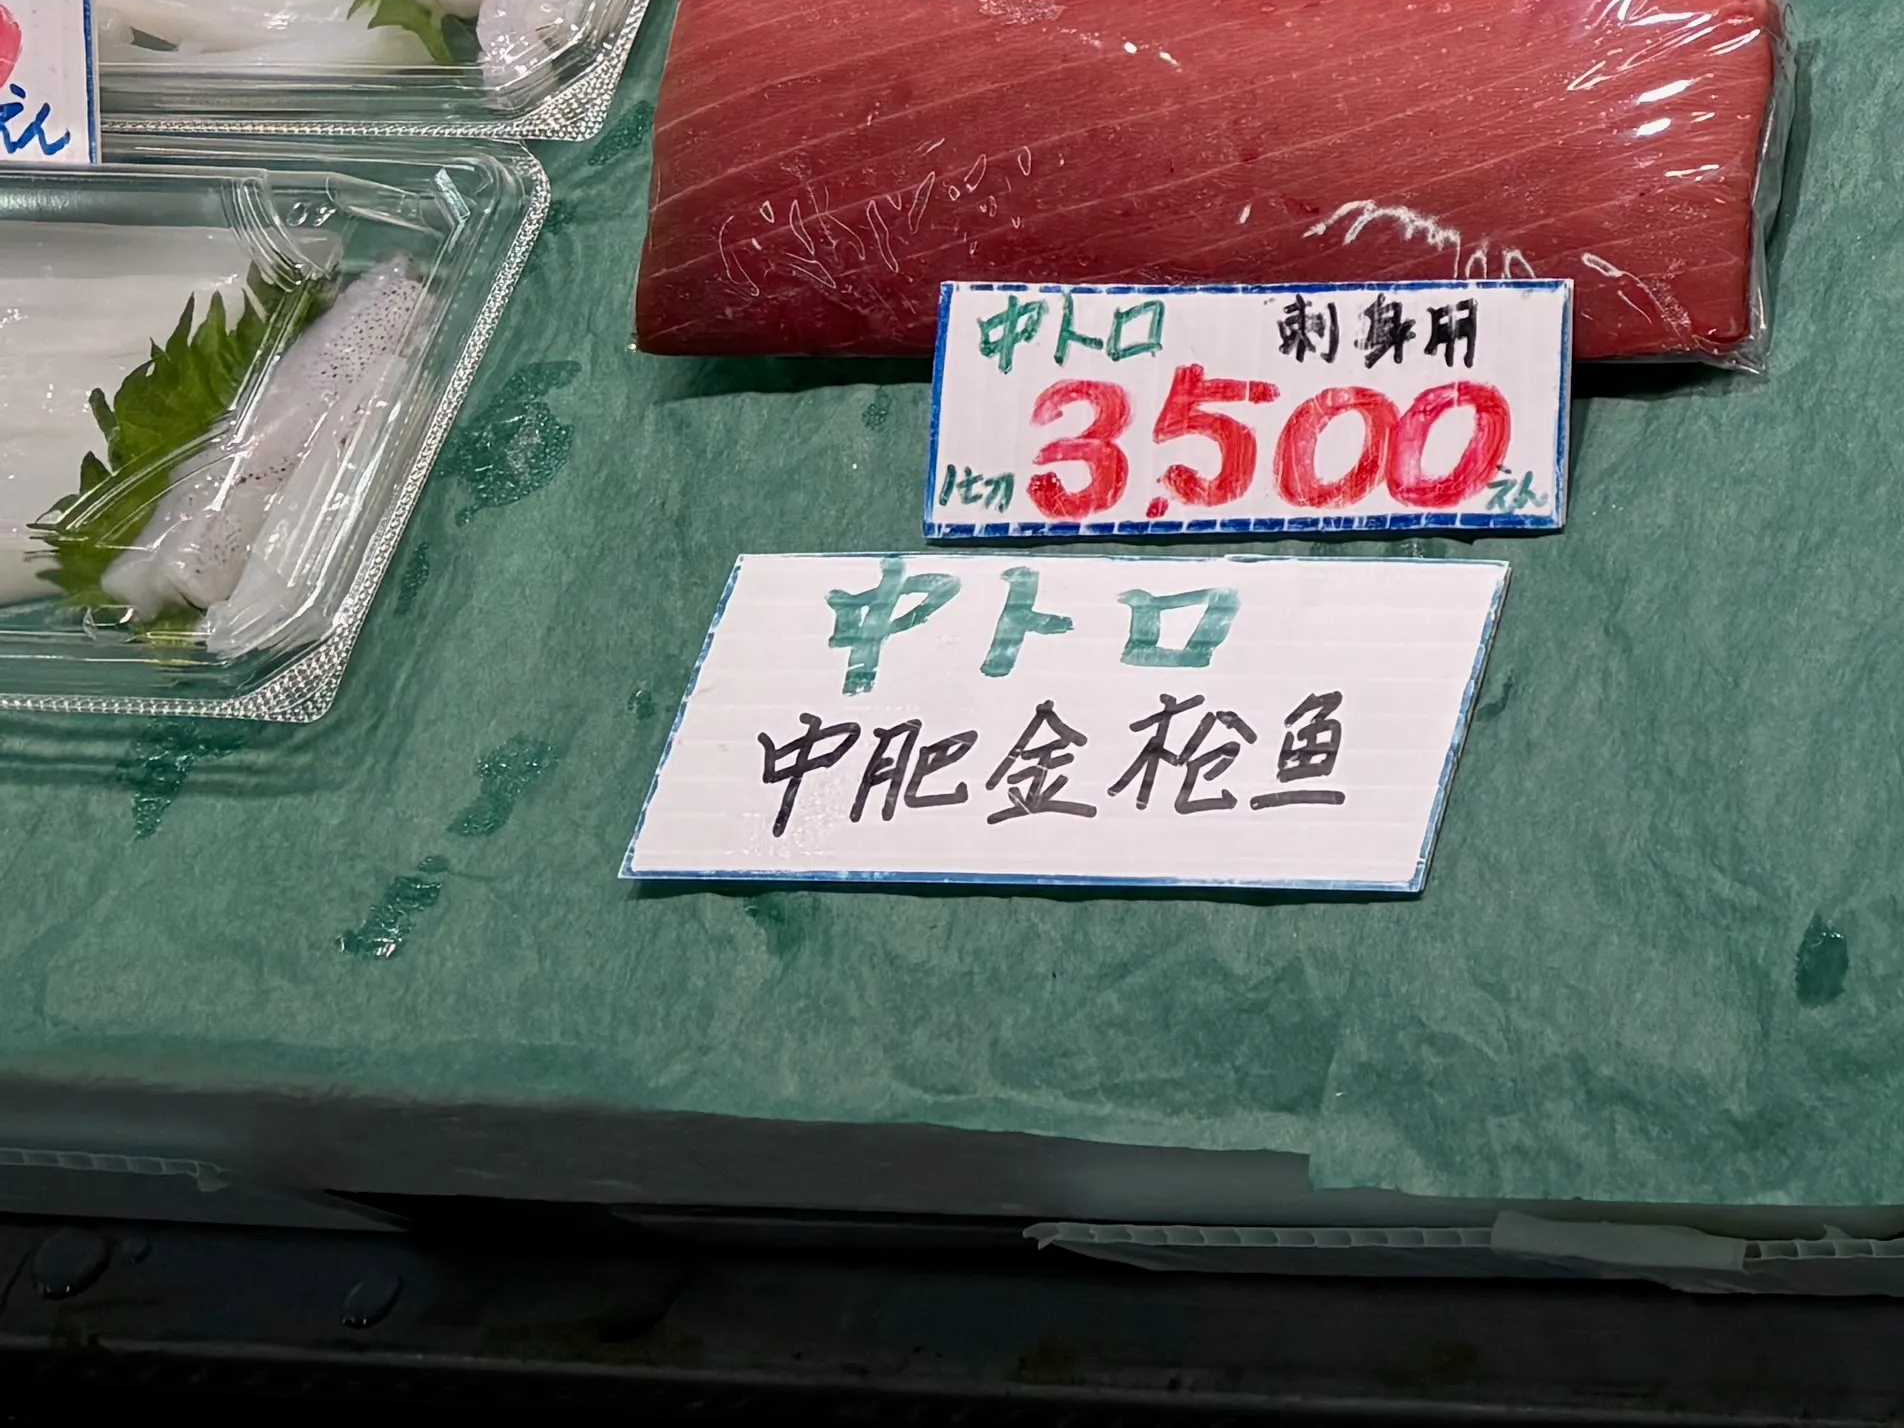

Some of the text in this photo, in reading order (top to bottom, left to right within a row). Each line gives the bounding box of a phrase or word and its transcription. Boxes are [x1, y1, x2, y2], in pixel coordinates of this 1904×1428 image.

[977, 293, 1478, 375] 中トロ 刺身用
[823, 557, 1243, 697] 中トロ
